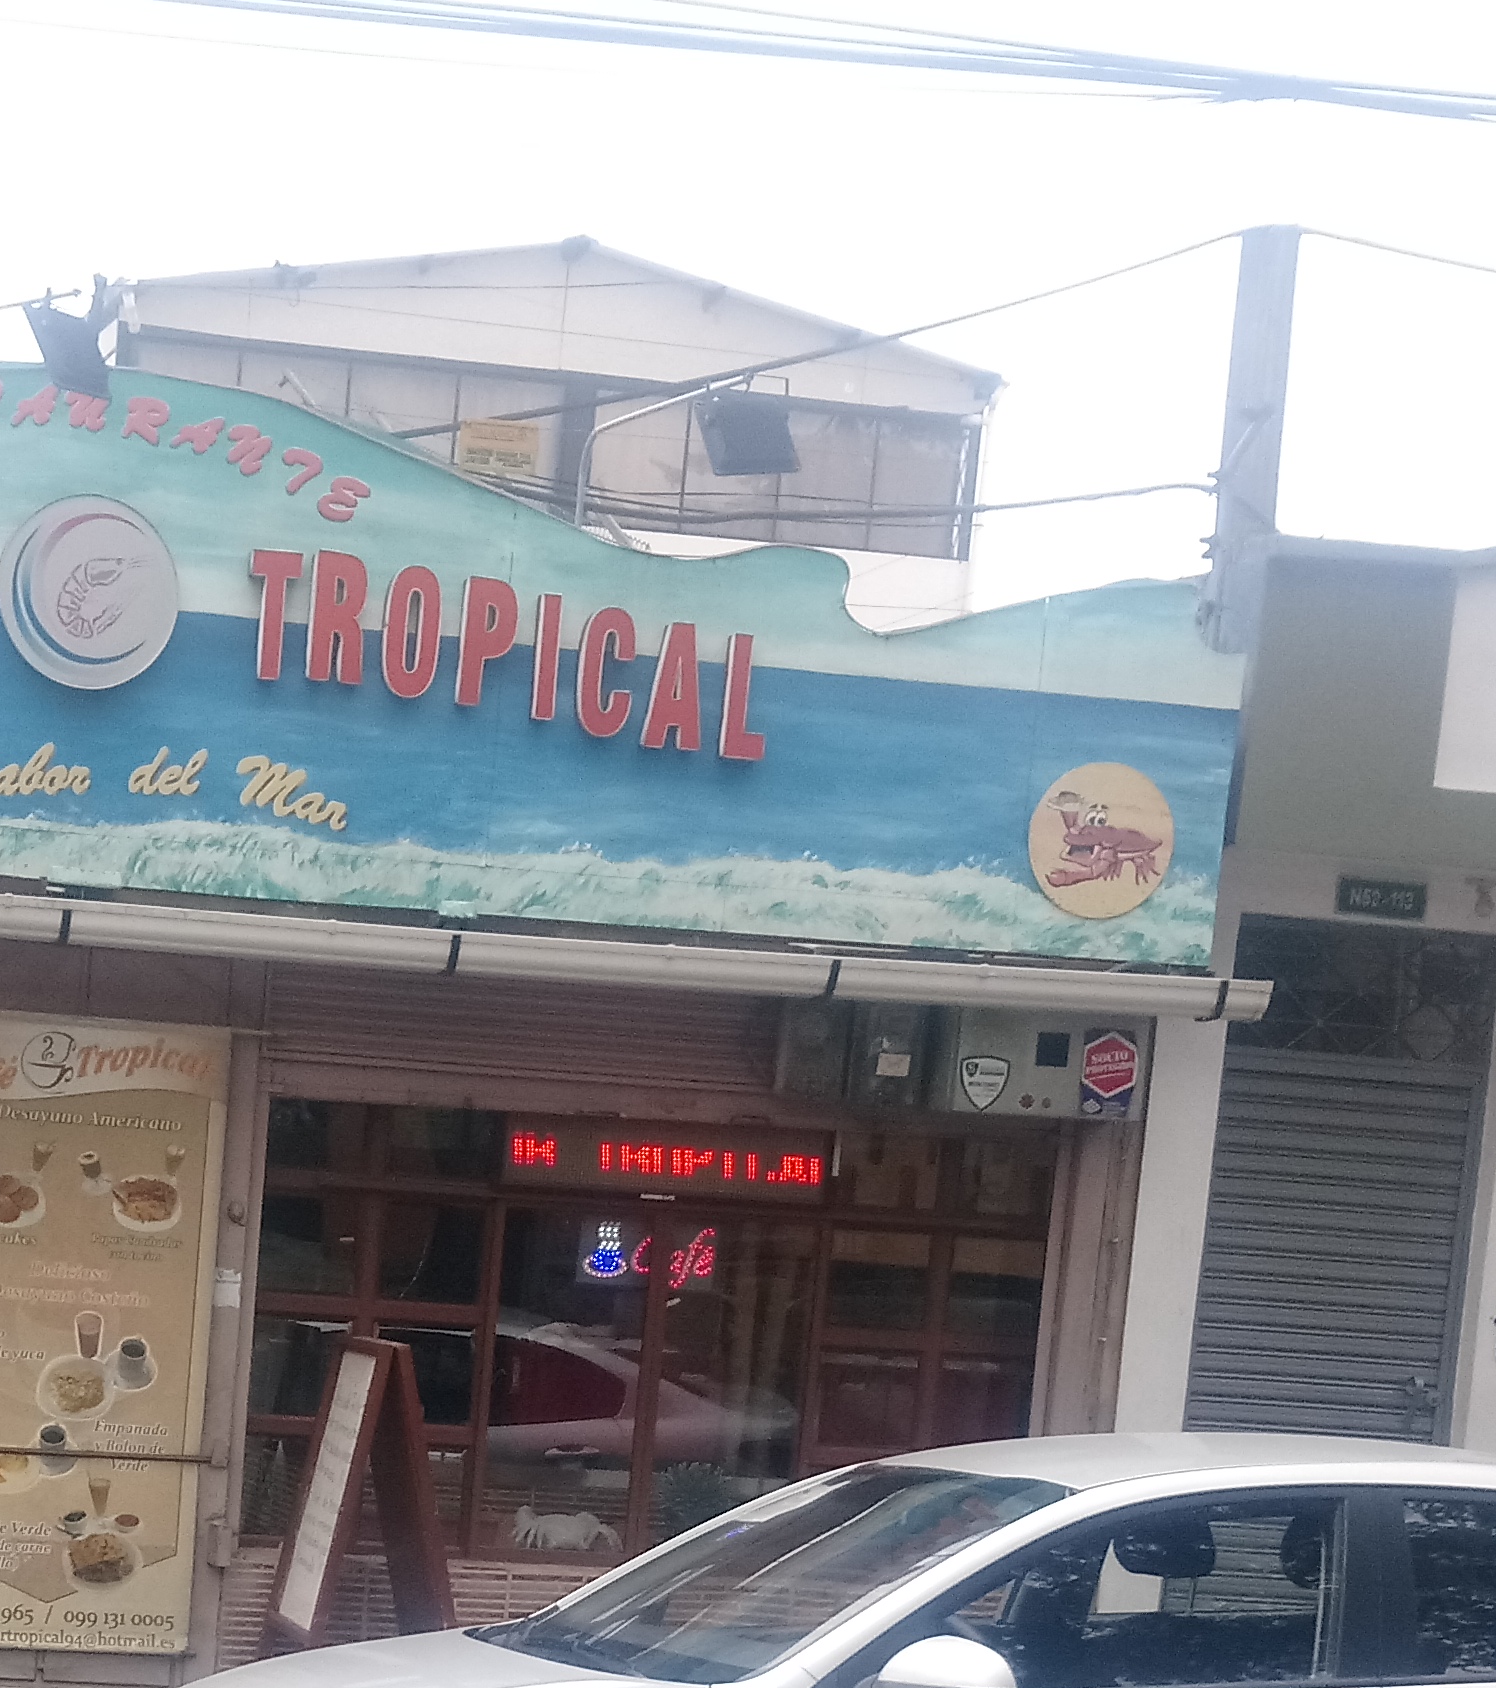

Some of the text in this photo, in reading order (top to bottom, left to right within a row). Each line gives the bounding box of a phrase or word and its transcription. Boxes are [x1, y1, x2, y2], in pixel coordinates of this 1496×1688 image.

[250, 548, 765, 762] TROPICAL
[128, 746, 208, 795] del
[237, 755, 347, 831] Mar
[88, 1111, 182, 1131] Americano
[95, 1420, 168, 1437] Empanada
[11, 1521, 51, 1536] Verde
[1, 1605, 34, 1625] 965
[64, 1610, 98, 1627] 099
[104, 1612, 125, 1629] 131
[131, 1612, 175, 1631] 0005
